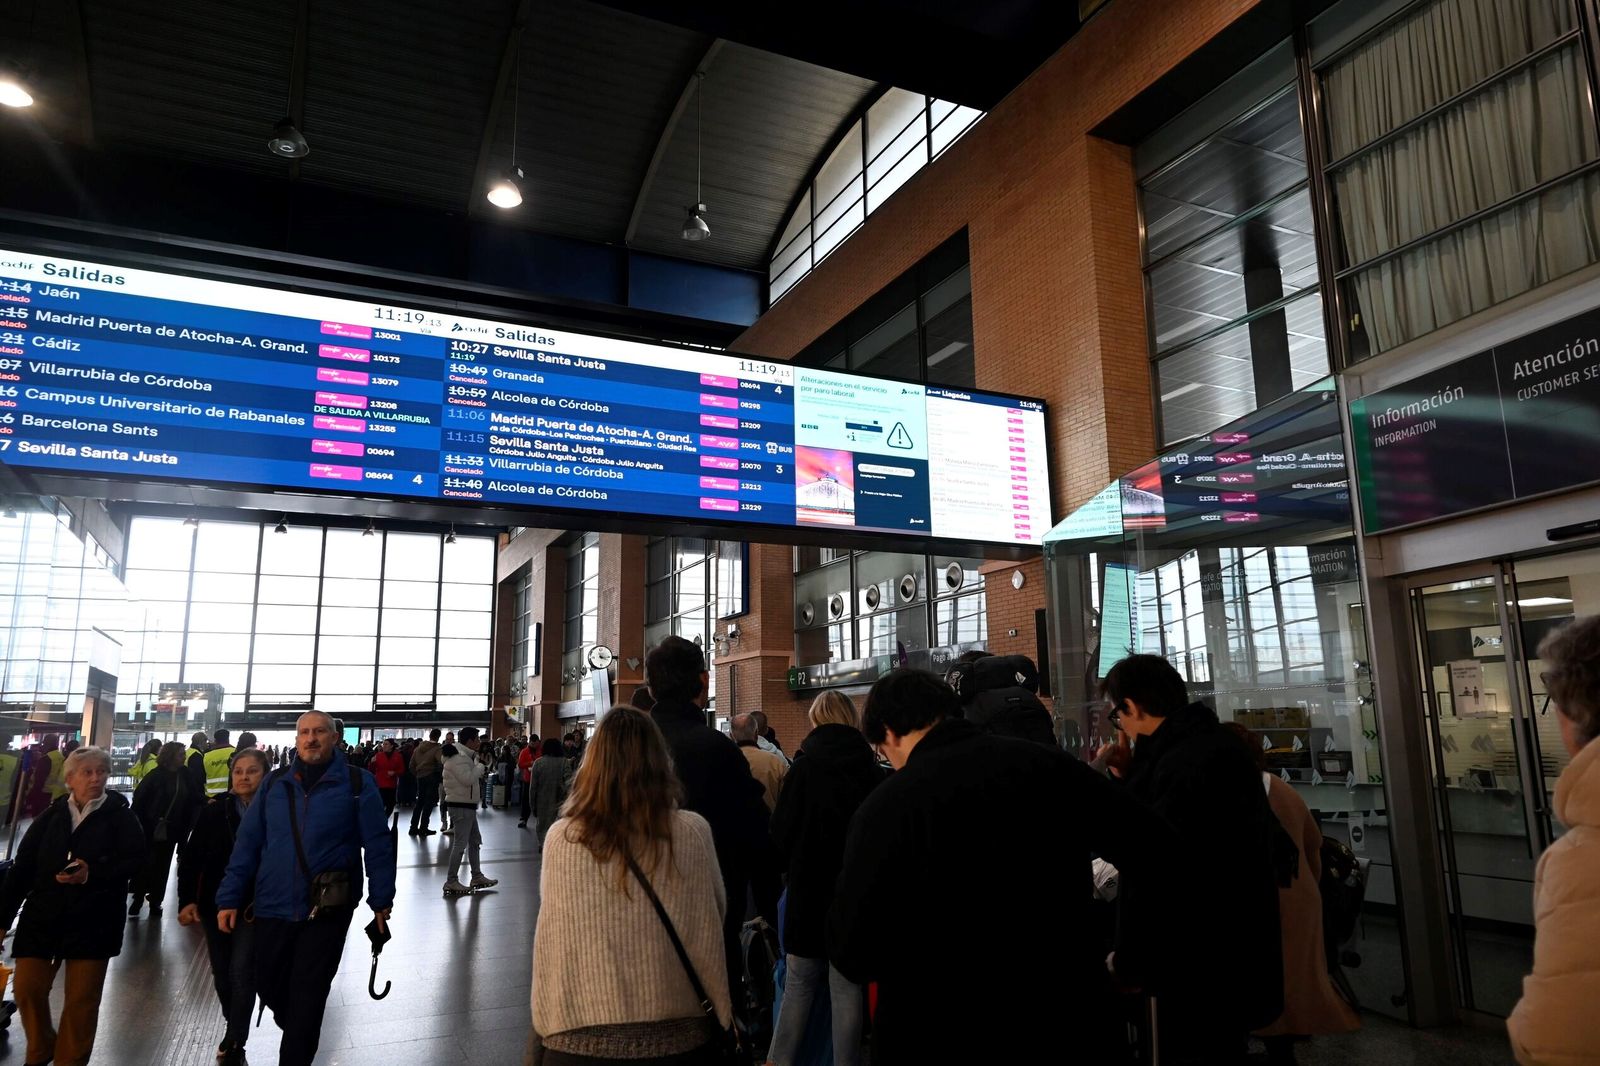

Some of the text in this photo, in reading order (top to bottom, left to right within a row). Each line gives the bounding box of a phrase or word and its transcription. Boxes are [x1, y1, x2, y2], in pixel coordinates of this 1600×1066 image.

[1, 261, 35, 270] adif
[43, 262, 125, 285] Salidas
[39, 285, 80, 300] Jaén
[36, 310, 94, 327] Madrid
[99, 318, 151, 334] Puerta
[156, 326, 176, 338] de
[179, 328, 256, 348] Atocha-A.
[260, 340, 308, 354] Grand.
[374, 332, 401, 341] 13001
[495, 328, 555, 346] Salidas
[32, 335, 80, 352] Cádiz
[373, 354, 400, 364] 10173
[450, 352, 476, 361] 11:19
[451, 340, 606, 370] 10:27 Sevilla Santa Justa
[1513, 337, 1599, 381] Atención
[30, 362, 115, 382] Villarrubia
[120, 372, 140, 384] de
[144, 374, 212, 392] Córdoba
[372, 377, 399, 386] 13079
[449, 375, 488, 385] Cancelado
[450, 364, 544, 384] 10:49 Granada
[774, 386, 782, 394] 4
[800, 376, 843, 387] Alteraciones
[862, 386, 888, 394] servicio
[832, 388, 854, 398] laboral
[1517, 370, 1580, 402] CUSTOMER
[25, 388, 95, 405] Campus
[100, 395, 202, 416] Universitario
[205, 406, 225, 418] de
[229, 408, 305, 426] Rabanales
[448, 386, 610, 413] 10:59 Alcolea de Córdoba
[448, 398, 486, 407] Cancelado
[1372, 384, 1464, 429] Información
[314, 405, 430, 424] DE SALIDA A VILLARRUBIA
[22, 414, 158, 437] Barcelona Sants
[368, 423, 396, 433] 13255
[448, 408, 692, 444] 11:06 Madrid Puerta de Atocha-A. Grand.
[1374, 419, 1437, 448] INFORMATION
[447, 431, 604, 456] 11:15 Sevilla Santa Justa
[564, 432, 604, 442] Pedroches
[610, 437, 652, 448] Puertollano
[656, 442, 682, 450] Ciudad
[778, 446, 792, 454] BUS
[18, 440, 76, 456] Sevilla
[80, 446, 128, 461] Santa
[132, 452, 178, 464] Justa
[367, 448, 395, 457] 00694
[490, 446, 524, 456] Córdoba
[526, 450, 546, 458] Julio
[547, 453, 576, 462] Anguita
[582, 456, 614, 465] Córdoba
[636, 461, 664, 470] Anguita
[444, 466, 484, 476] Cancelado
[446, 454, 624, 480] 11:33 Villarrubia de Córdoba
[776, 464, 783, 474] 3
[366, 472, 423, 485] 08694 4
[444, 489, 482, 498] Cancelado
[488, 481, 535, 494] Alcolea
[538, 486, 554, 496] de
[556, 486, 608, 500] Córdoba
[932, 654, 946, 664] Pago
[798, 672, 806, 684] P2
